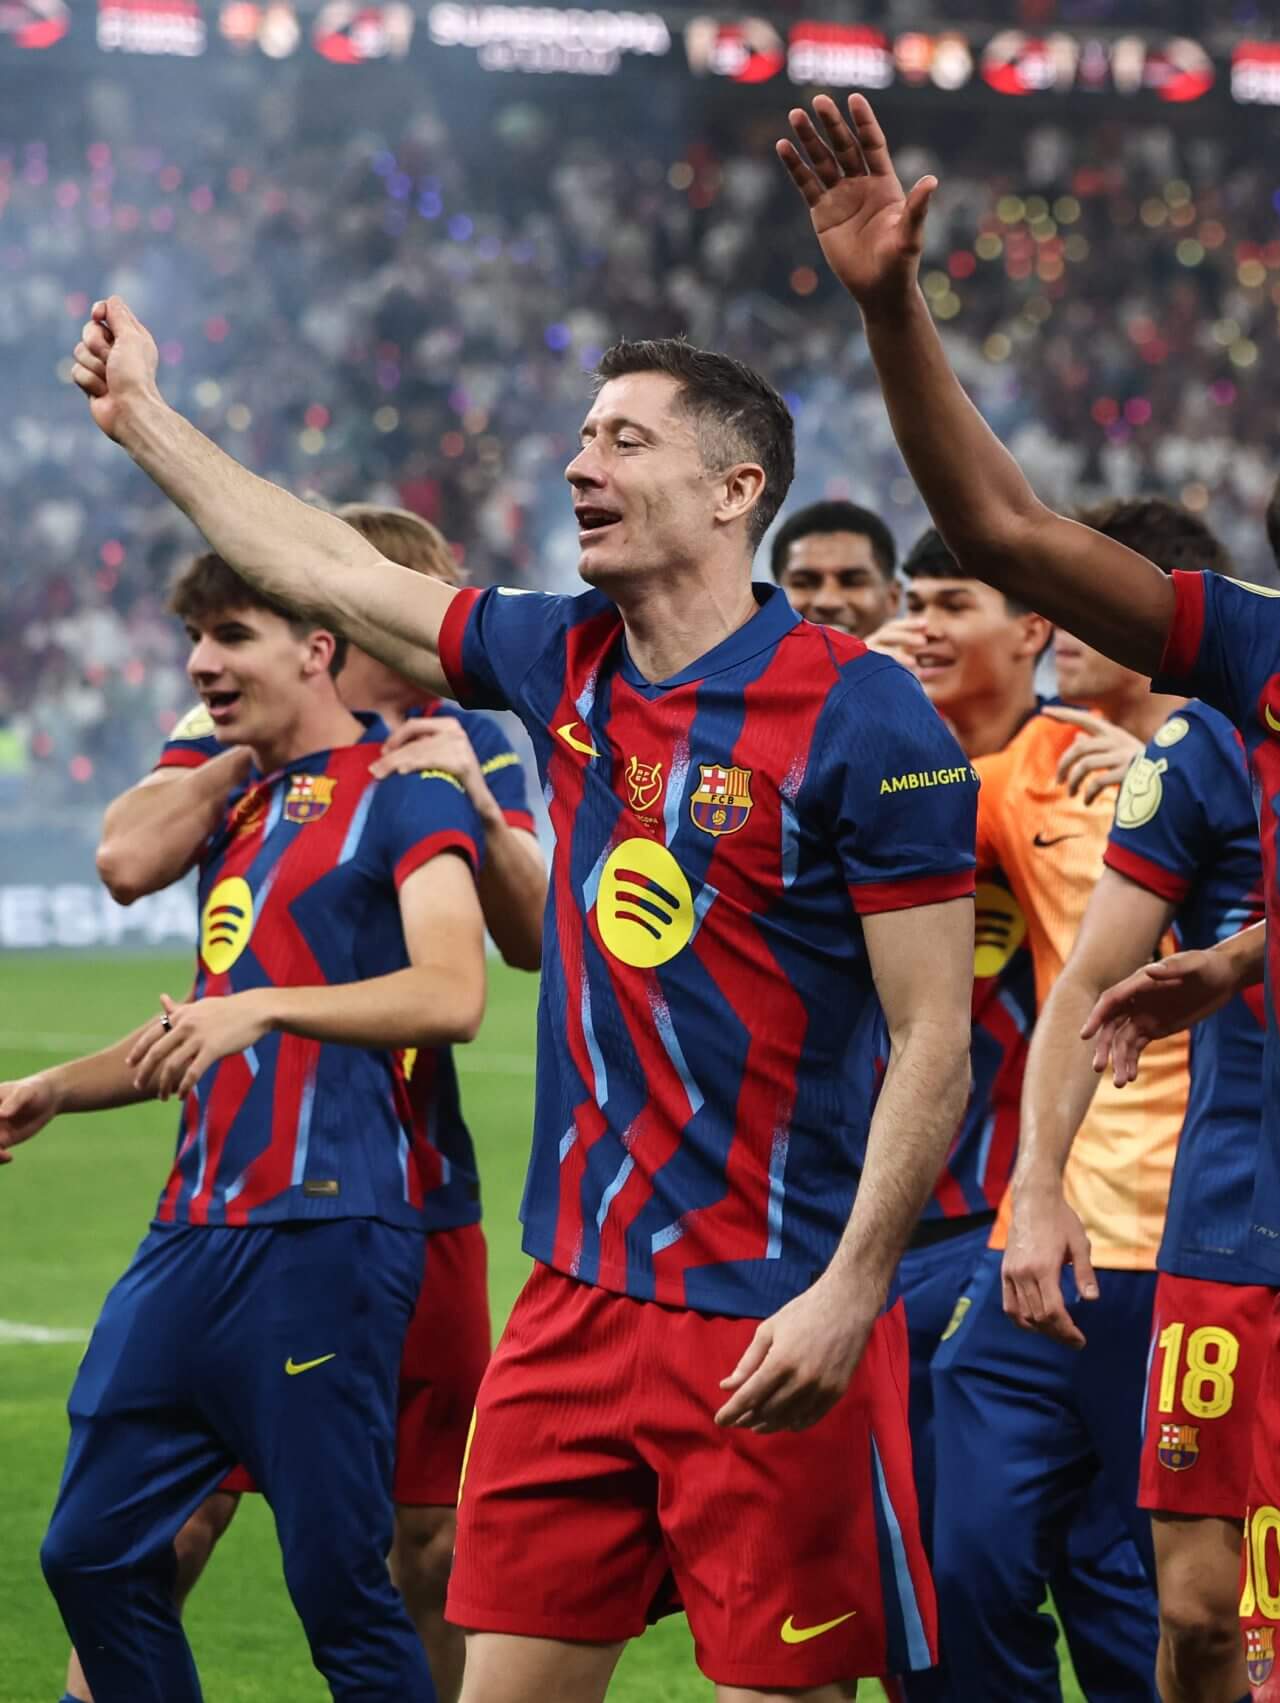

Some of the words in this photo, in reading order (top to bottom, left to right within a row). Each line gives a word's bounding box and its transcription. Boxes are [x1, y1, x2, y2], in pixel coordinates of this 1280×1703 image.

[880, 767, 967, 795] AMBILIGHT
[711, 795, 734, 804] FCB
[1158, 1322, 1240, 1419] 18
